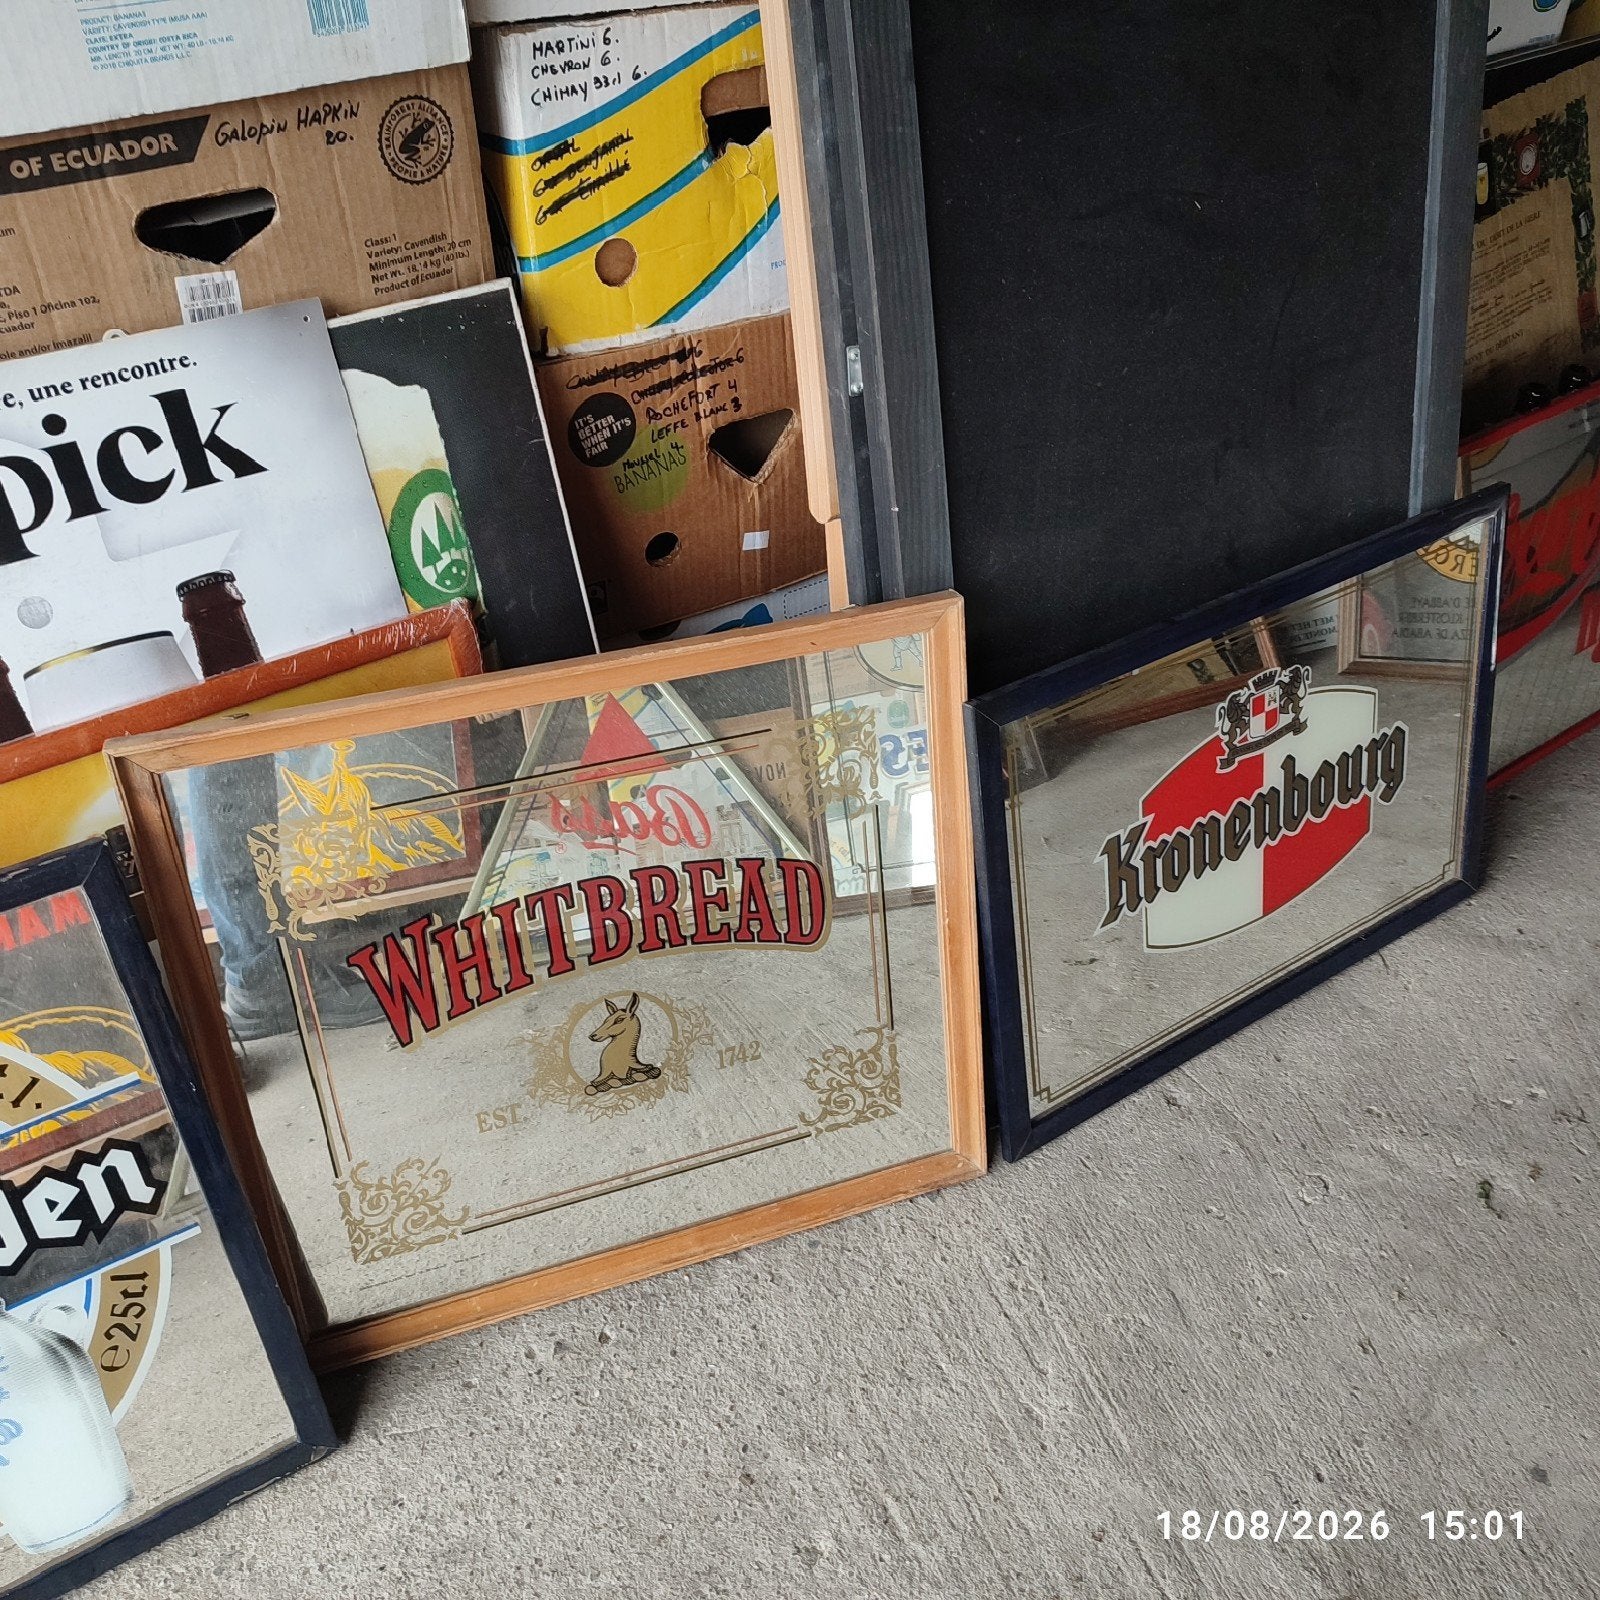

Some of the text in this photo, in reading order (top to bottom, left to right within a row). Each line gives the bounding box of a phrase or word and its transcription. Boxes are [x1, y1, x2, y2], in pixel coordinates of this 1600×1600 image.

[10, 133, 179, 180] OF ECUADOR
[404, 232, 447, 251] Cavendish
[369, 254, 412, 272] Minimum
[458, 239, 472, 248] cm
[370, 274, 389, 284] Net
[374, 266, 454, 296] Product of Ecuador
[8, 308, 30, 320] Piso
[40, 299, 77, 315] Oficina
[18, 343, 51, 356] and/or
[0, 354, 198, 410] e, une rencontre.
[728, 379, 738, 393] 4
[574, 414, 595, 429] IT'S
[578, 415, 615, 440] BETTER
[581, 417, 632, 450] WHEN IT'S
[652, 419, 689, 443] LEFFE
[585, 441, 609, 458] FAIR
[614, 451, 687, 493] BANANAS
[1097, 721, 1409, 931] Kronenbourg
[347, 856, 829, 1050] WHITBREAD
[717, 1041, 762, 1070] 1742
